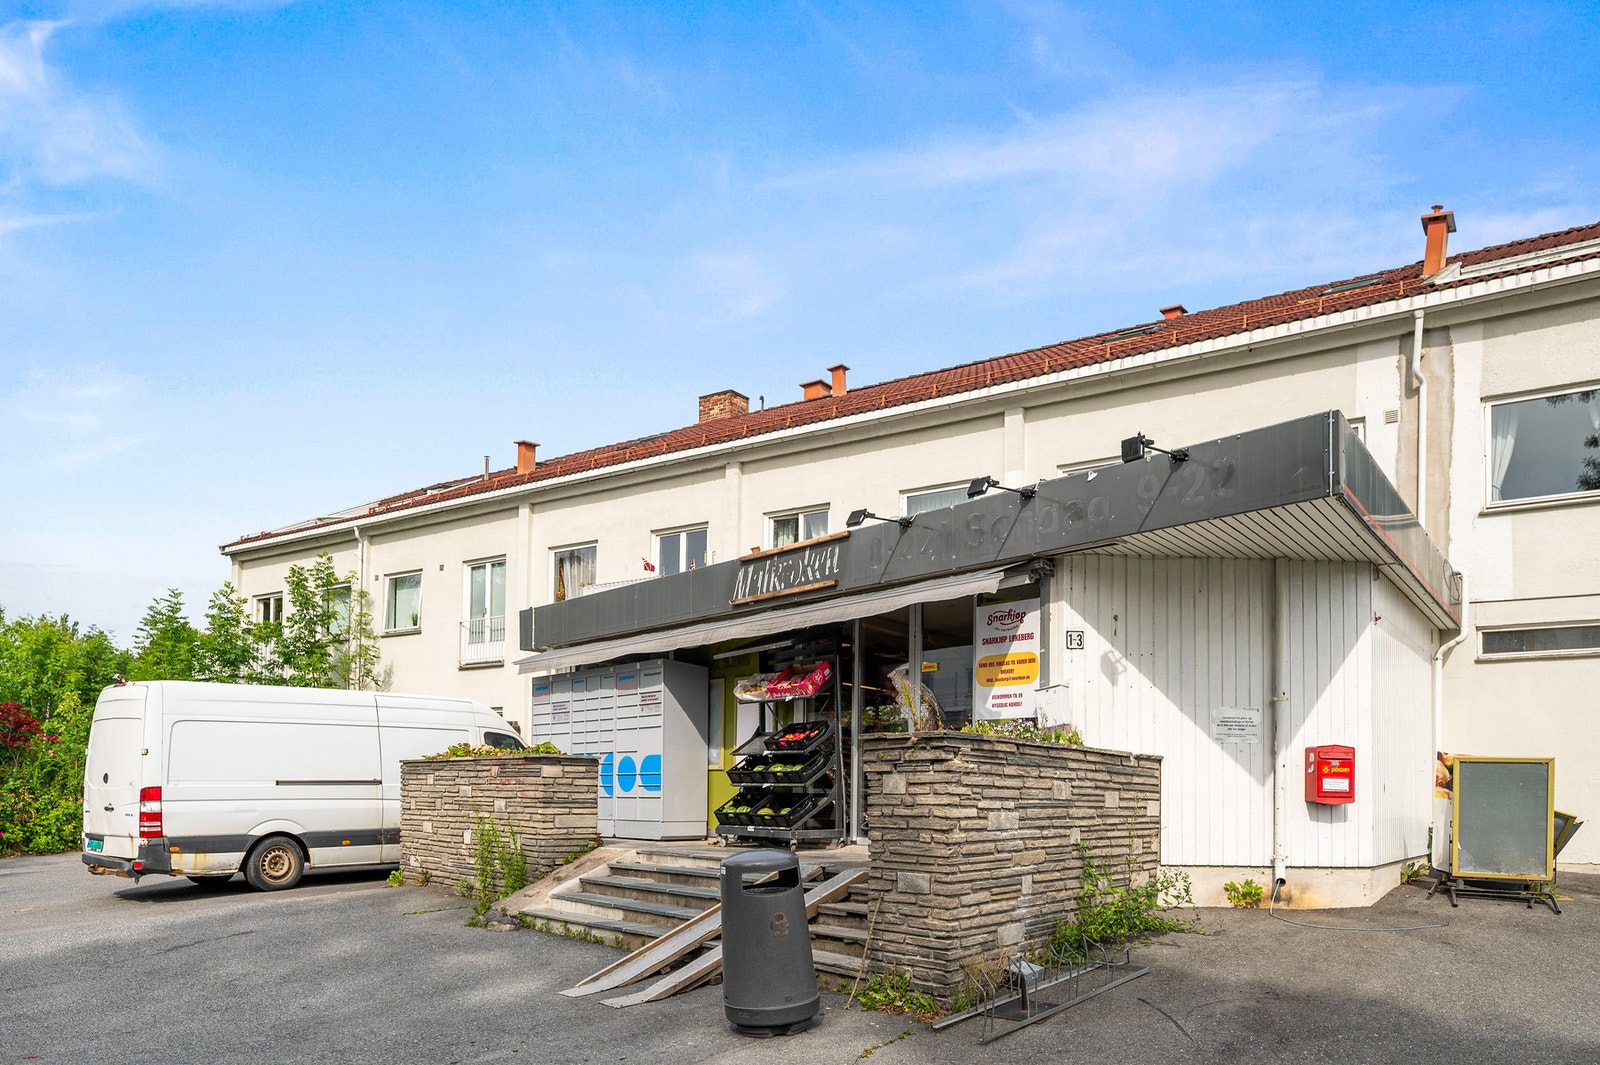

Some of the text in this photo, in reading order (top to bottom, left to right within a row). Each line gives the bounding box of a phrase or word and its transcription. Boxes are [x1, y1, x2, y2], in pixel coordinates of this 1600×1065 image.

[987, 608, 1026, 626] Snarkjøp
[981, 632, 1035, 646] SNARKJØP LØKEBERG
[1068, 633, 1083, 647] 1-3
